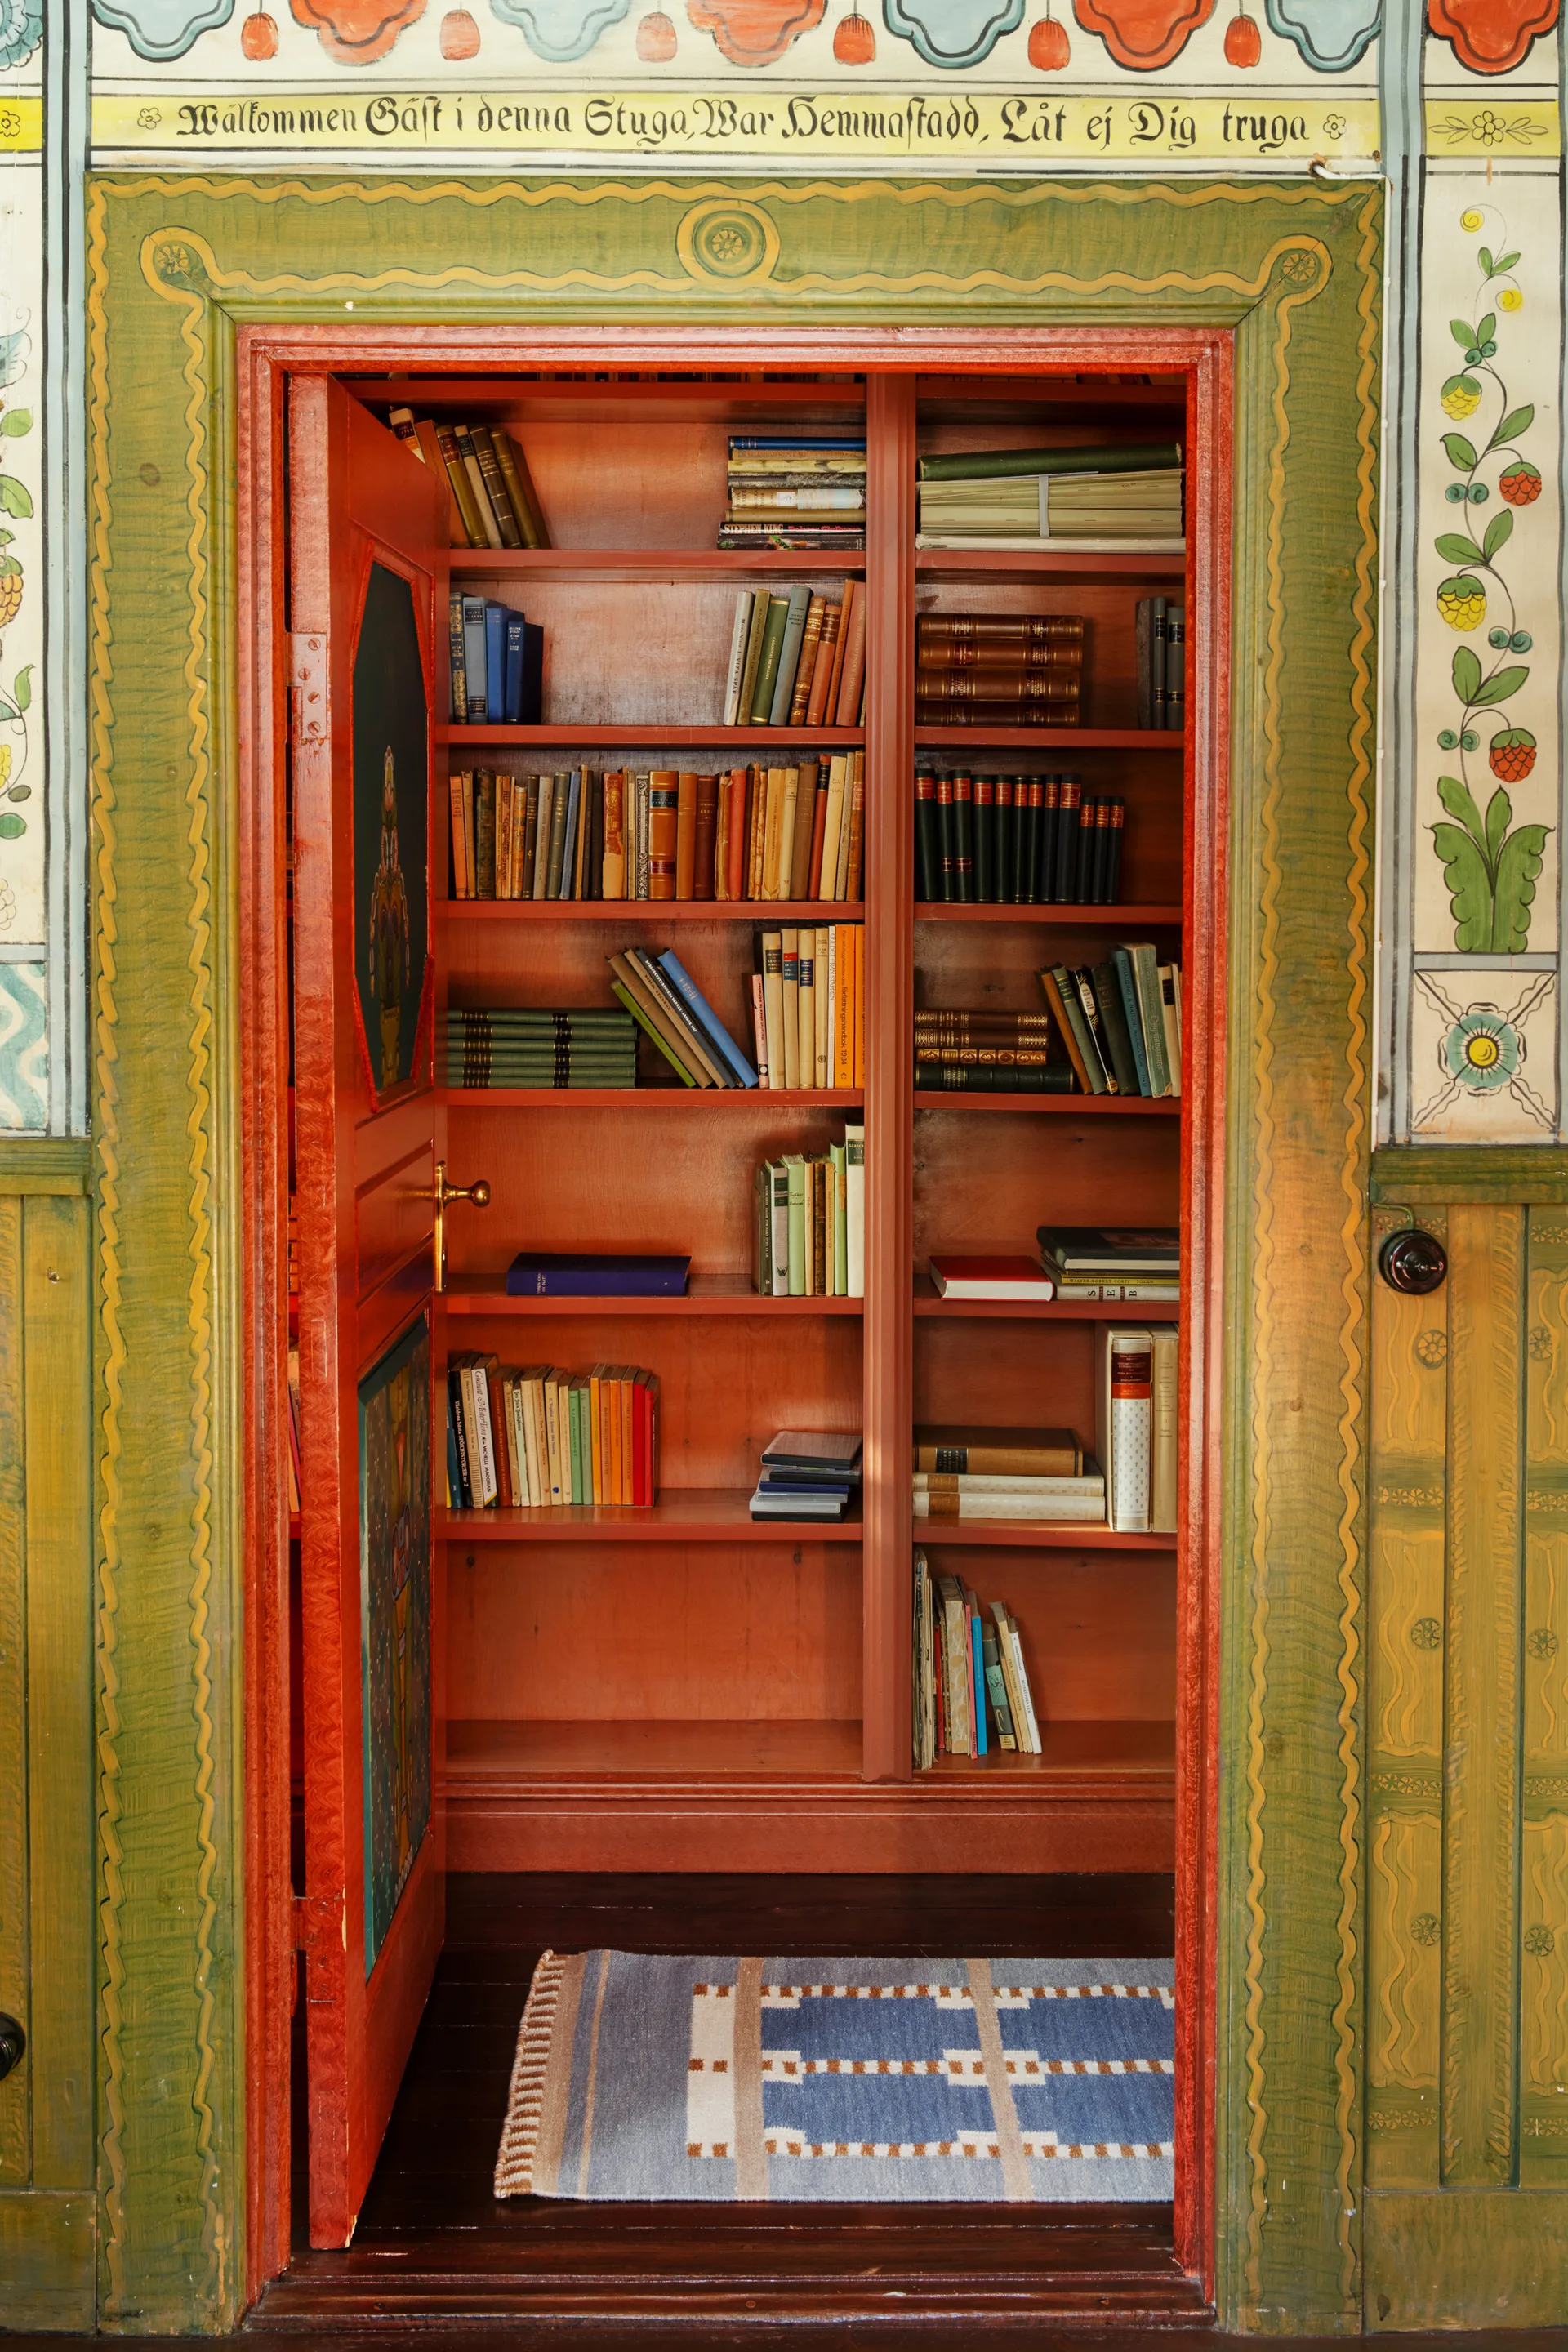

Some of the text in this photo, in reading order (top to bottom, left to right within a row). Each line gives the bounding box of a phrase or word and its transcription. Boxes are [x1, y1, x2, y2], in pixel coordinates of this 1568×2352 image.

[456, 96, 463, 131] i
[476, 94, 572, 132] denna
[1000, 98, 1066, 142] Låt
[1086, 105, 1113, 151] ej
[1127, 101, 1196, 151] Dig
[1222, 102, 1310, 153] truga
[724, 523, 784, 534] STEPHEN KING
[731, 677, 739, 695] SPÅR
[839, 986, 848, 1048] författningshandbok
[474, 1370, 485, 1396] Godnatt
[476, 1396, 488, 1423] Mister
[453, 1400, 461, 1421] Världens
[458, 1434, 466, 1477] SPÖKHISTORIER
[479, 1421, 488, 1435] Tom
[483, 1466, 492, 1493] MAGORIAN
